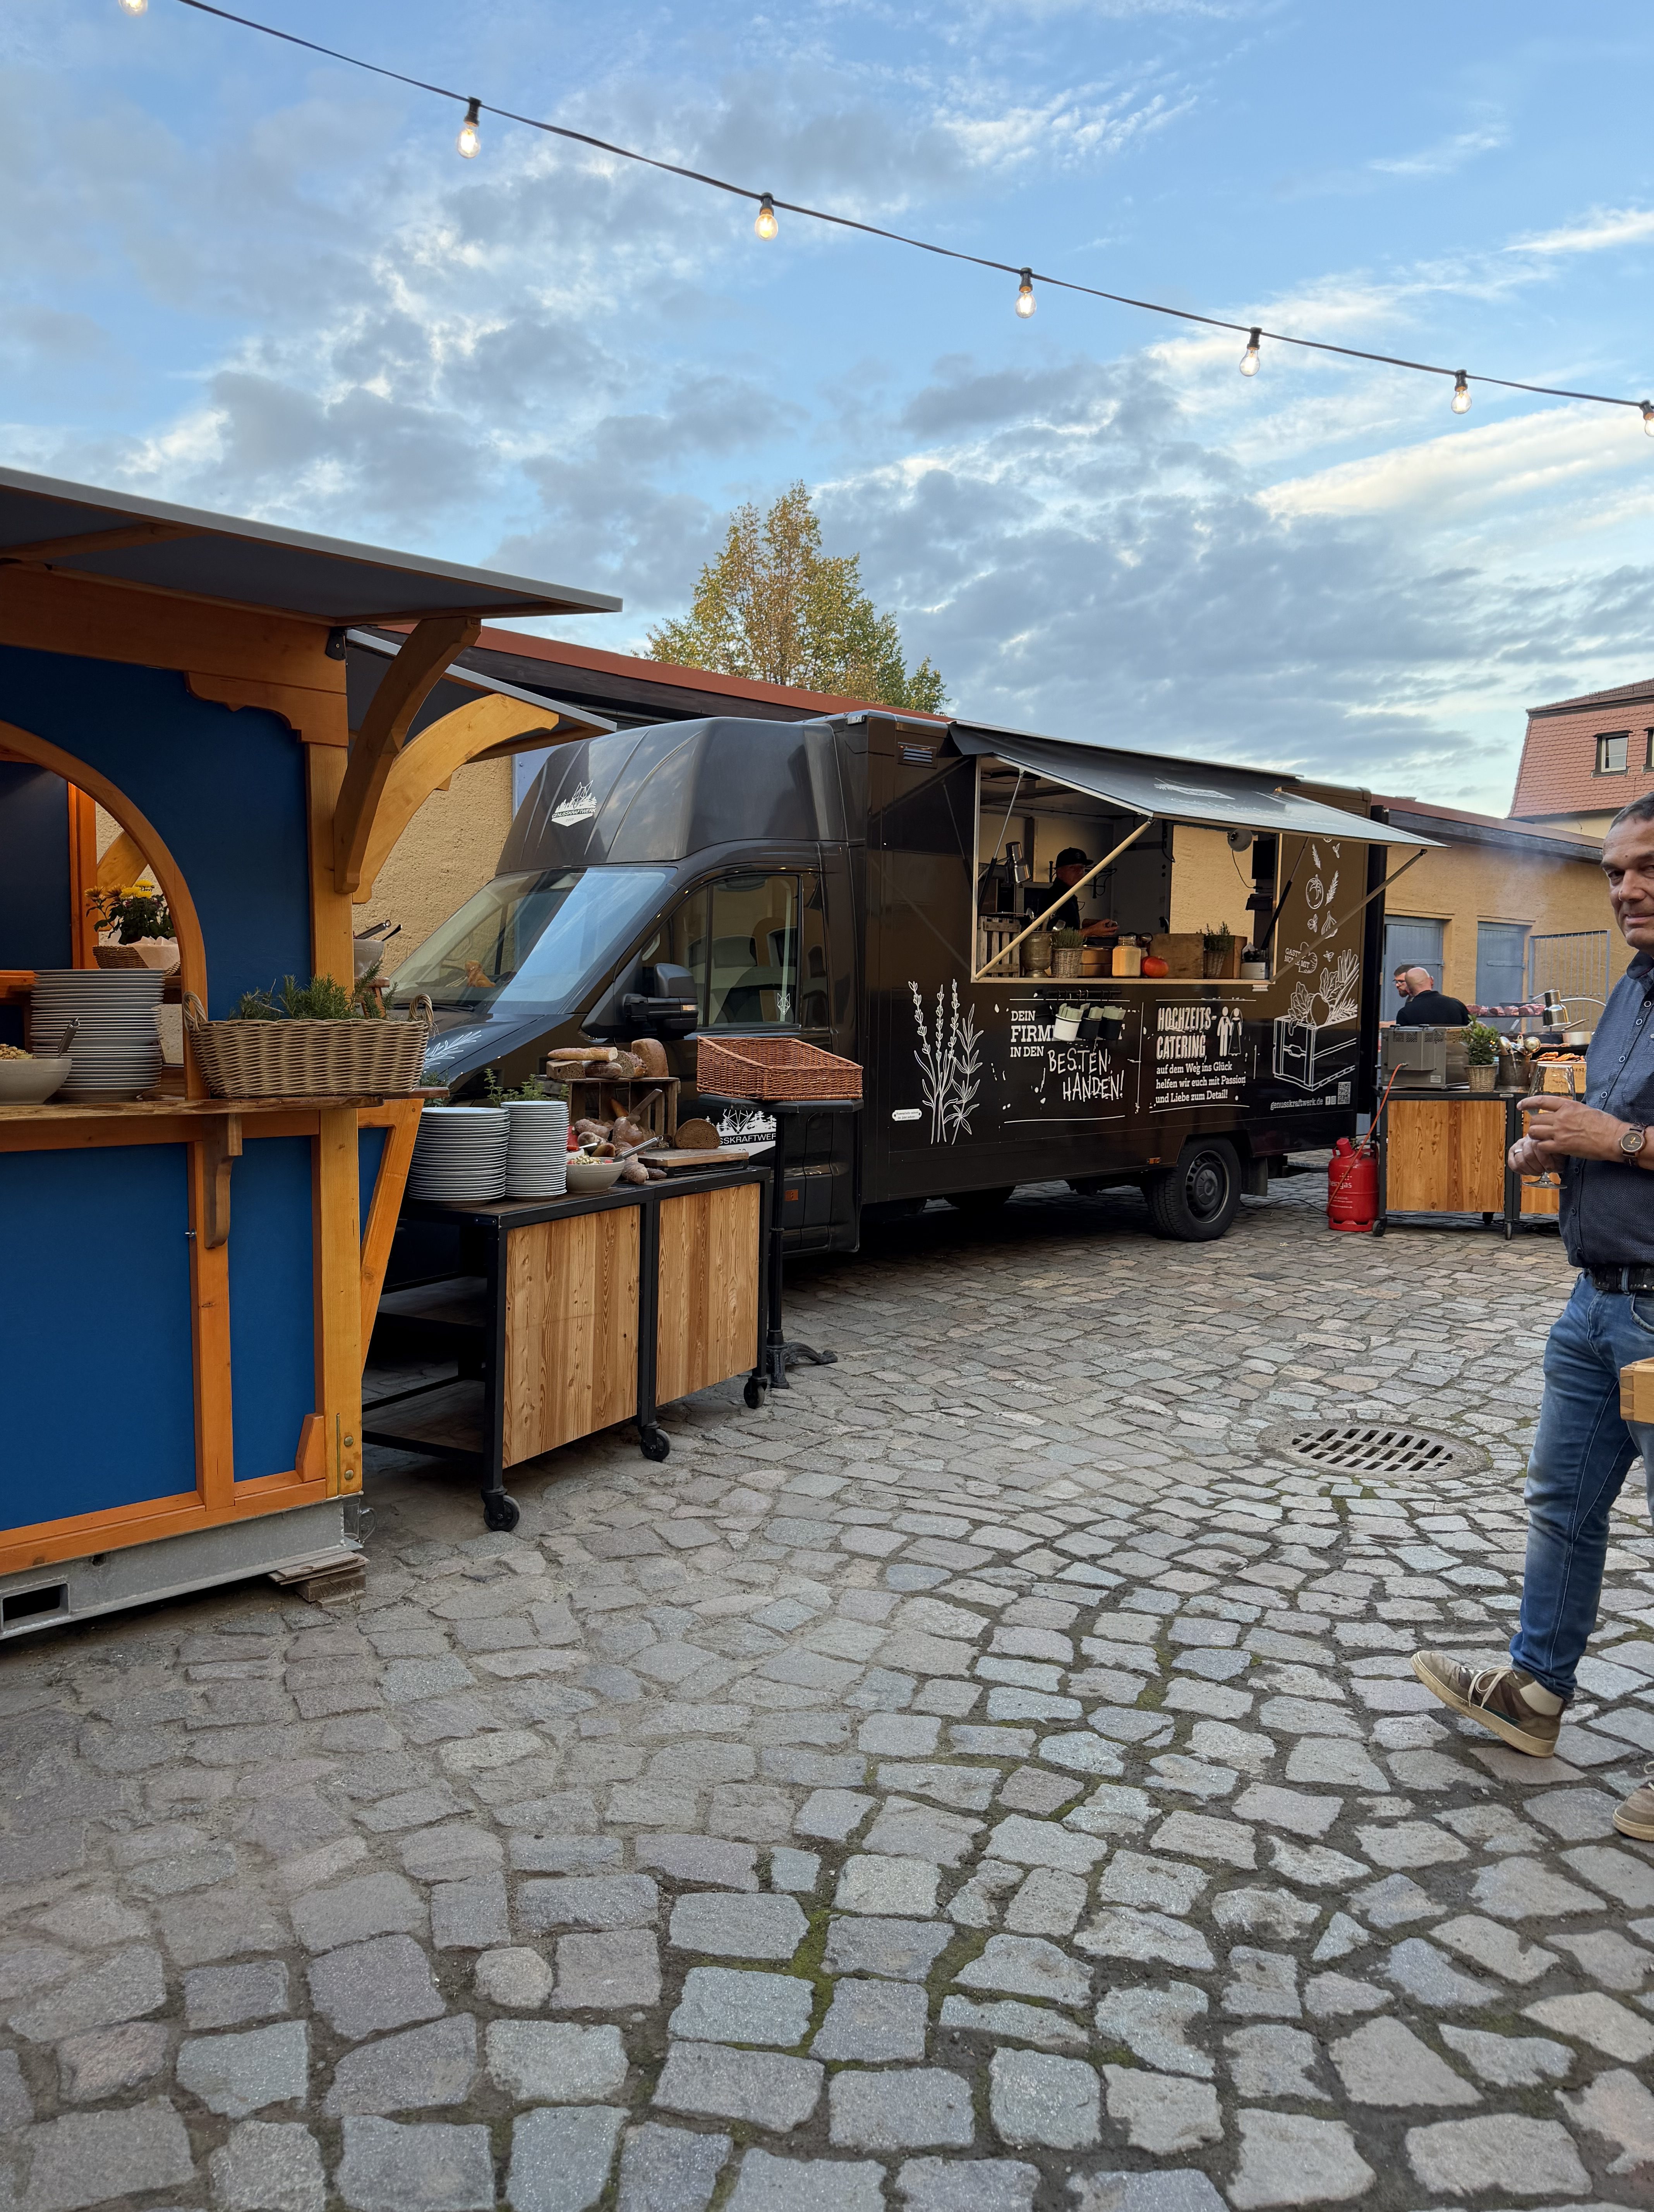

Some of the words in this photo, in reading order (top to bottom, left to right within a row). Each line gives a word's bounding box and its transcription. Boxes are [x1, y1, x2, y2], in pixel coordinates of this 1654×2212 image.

[552, 808, 596, 818] GENUSSKRAFTWERK
[1011, 1010, 1036, 1022] DEIN
[1157, 1007, 1217, 1032] HOCHZEITS-
[1010, 1046, 1021, 1057] IN
[1023, 1046, 1044, 1057] DEN
[1047, 1048, 1108, 1075] BESTEN
[1156, 1064, 1168, 1075] auf
[1169, 1064, 1184, 1073] dem
[1186, 1063, 1200, 1075] Weg
[1202, 1063, 1211, 1072] ins
[1213, 1061, 1232, 1071] Glück
[1156, 1079, 1177, 1089] helfen
[1179, 1078, 1190, 1087] wir
[1192, 1076, 1207, 1086] euch
[1208, 1076, 1220, 1085] mit
[1221, 1075, 1246, 1085] Passion
[1155, 1093, 1169, 1103] und
[1170, 1092, 1189, 1102] Liebe
[1206, 1089, 1228, 1099] Detail!
[1270, 1097, 1323, 1110] genusskraftwerk.de
